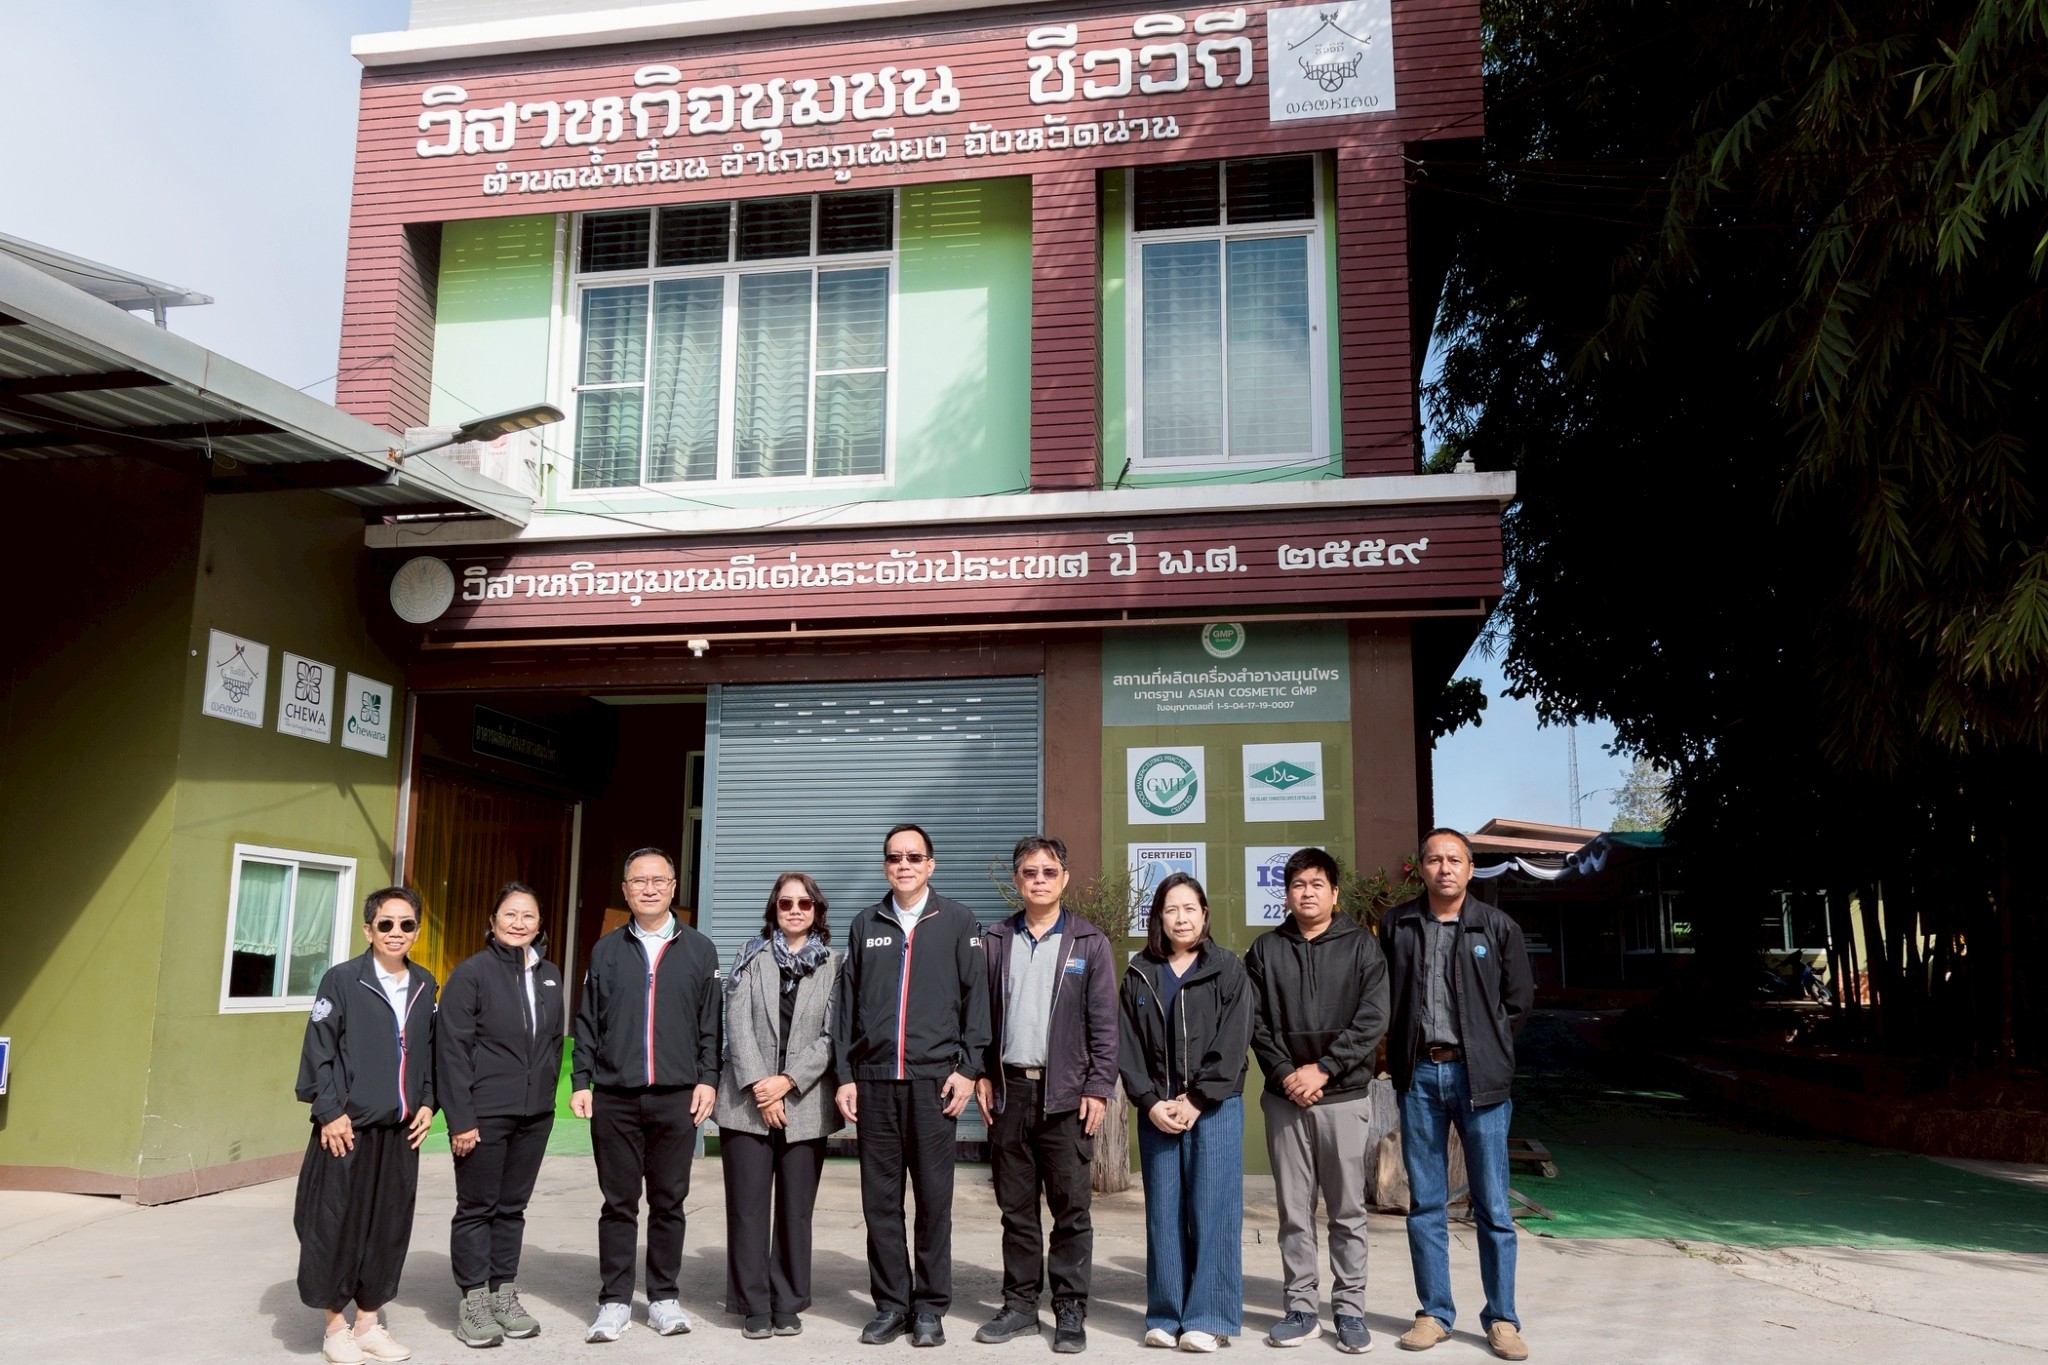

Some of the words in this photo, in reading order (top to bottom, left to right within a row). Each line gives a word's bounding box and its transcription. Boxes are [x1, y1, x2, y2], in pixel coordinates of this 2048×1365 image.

[415, 64, 961, 159] วิสาหกิจชุมชน
[1027, 8, 1255, 106] ชีววิถี
[963, 109, 1181, 158] จังหวัดน่าน
[461, 544, 1090, 607] วิสาหกิจชุมชนดีเด่นระดับประเทศ
[1106, 531, 1138, 577] ปี
[1277, 537, 1430, 571] ๒๕๕๙
[1212, 629, 1235, 639] GMP
[1112, 665, 1340, 687] สถานที่ผลิตเครื่องสำอางสมุนไพร
[1134, 690, 1183, 702] มาตรฐาน
[1188, 688, 1225, 699] ASIAN
[1228, 686, 1287, 698] COSMETIC
[1291, 685, 1318, 697] GMP
[285, 703, 326, 726] CHEWA
[1217, 701, 1294, 710] 1-5-04-17-19-0007
[347, 715, 386, 742] Chewana
[1265, 766, 1300, 783] حلال
[1147, 778, 1187, 792] GMP
[1141, 851, 1192, 859] CERTIFIED
[1257, 866, 1285, 887] IS
[866, 936, 892, 948] BOD
